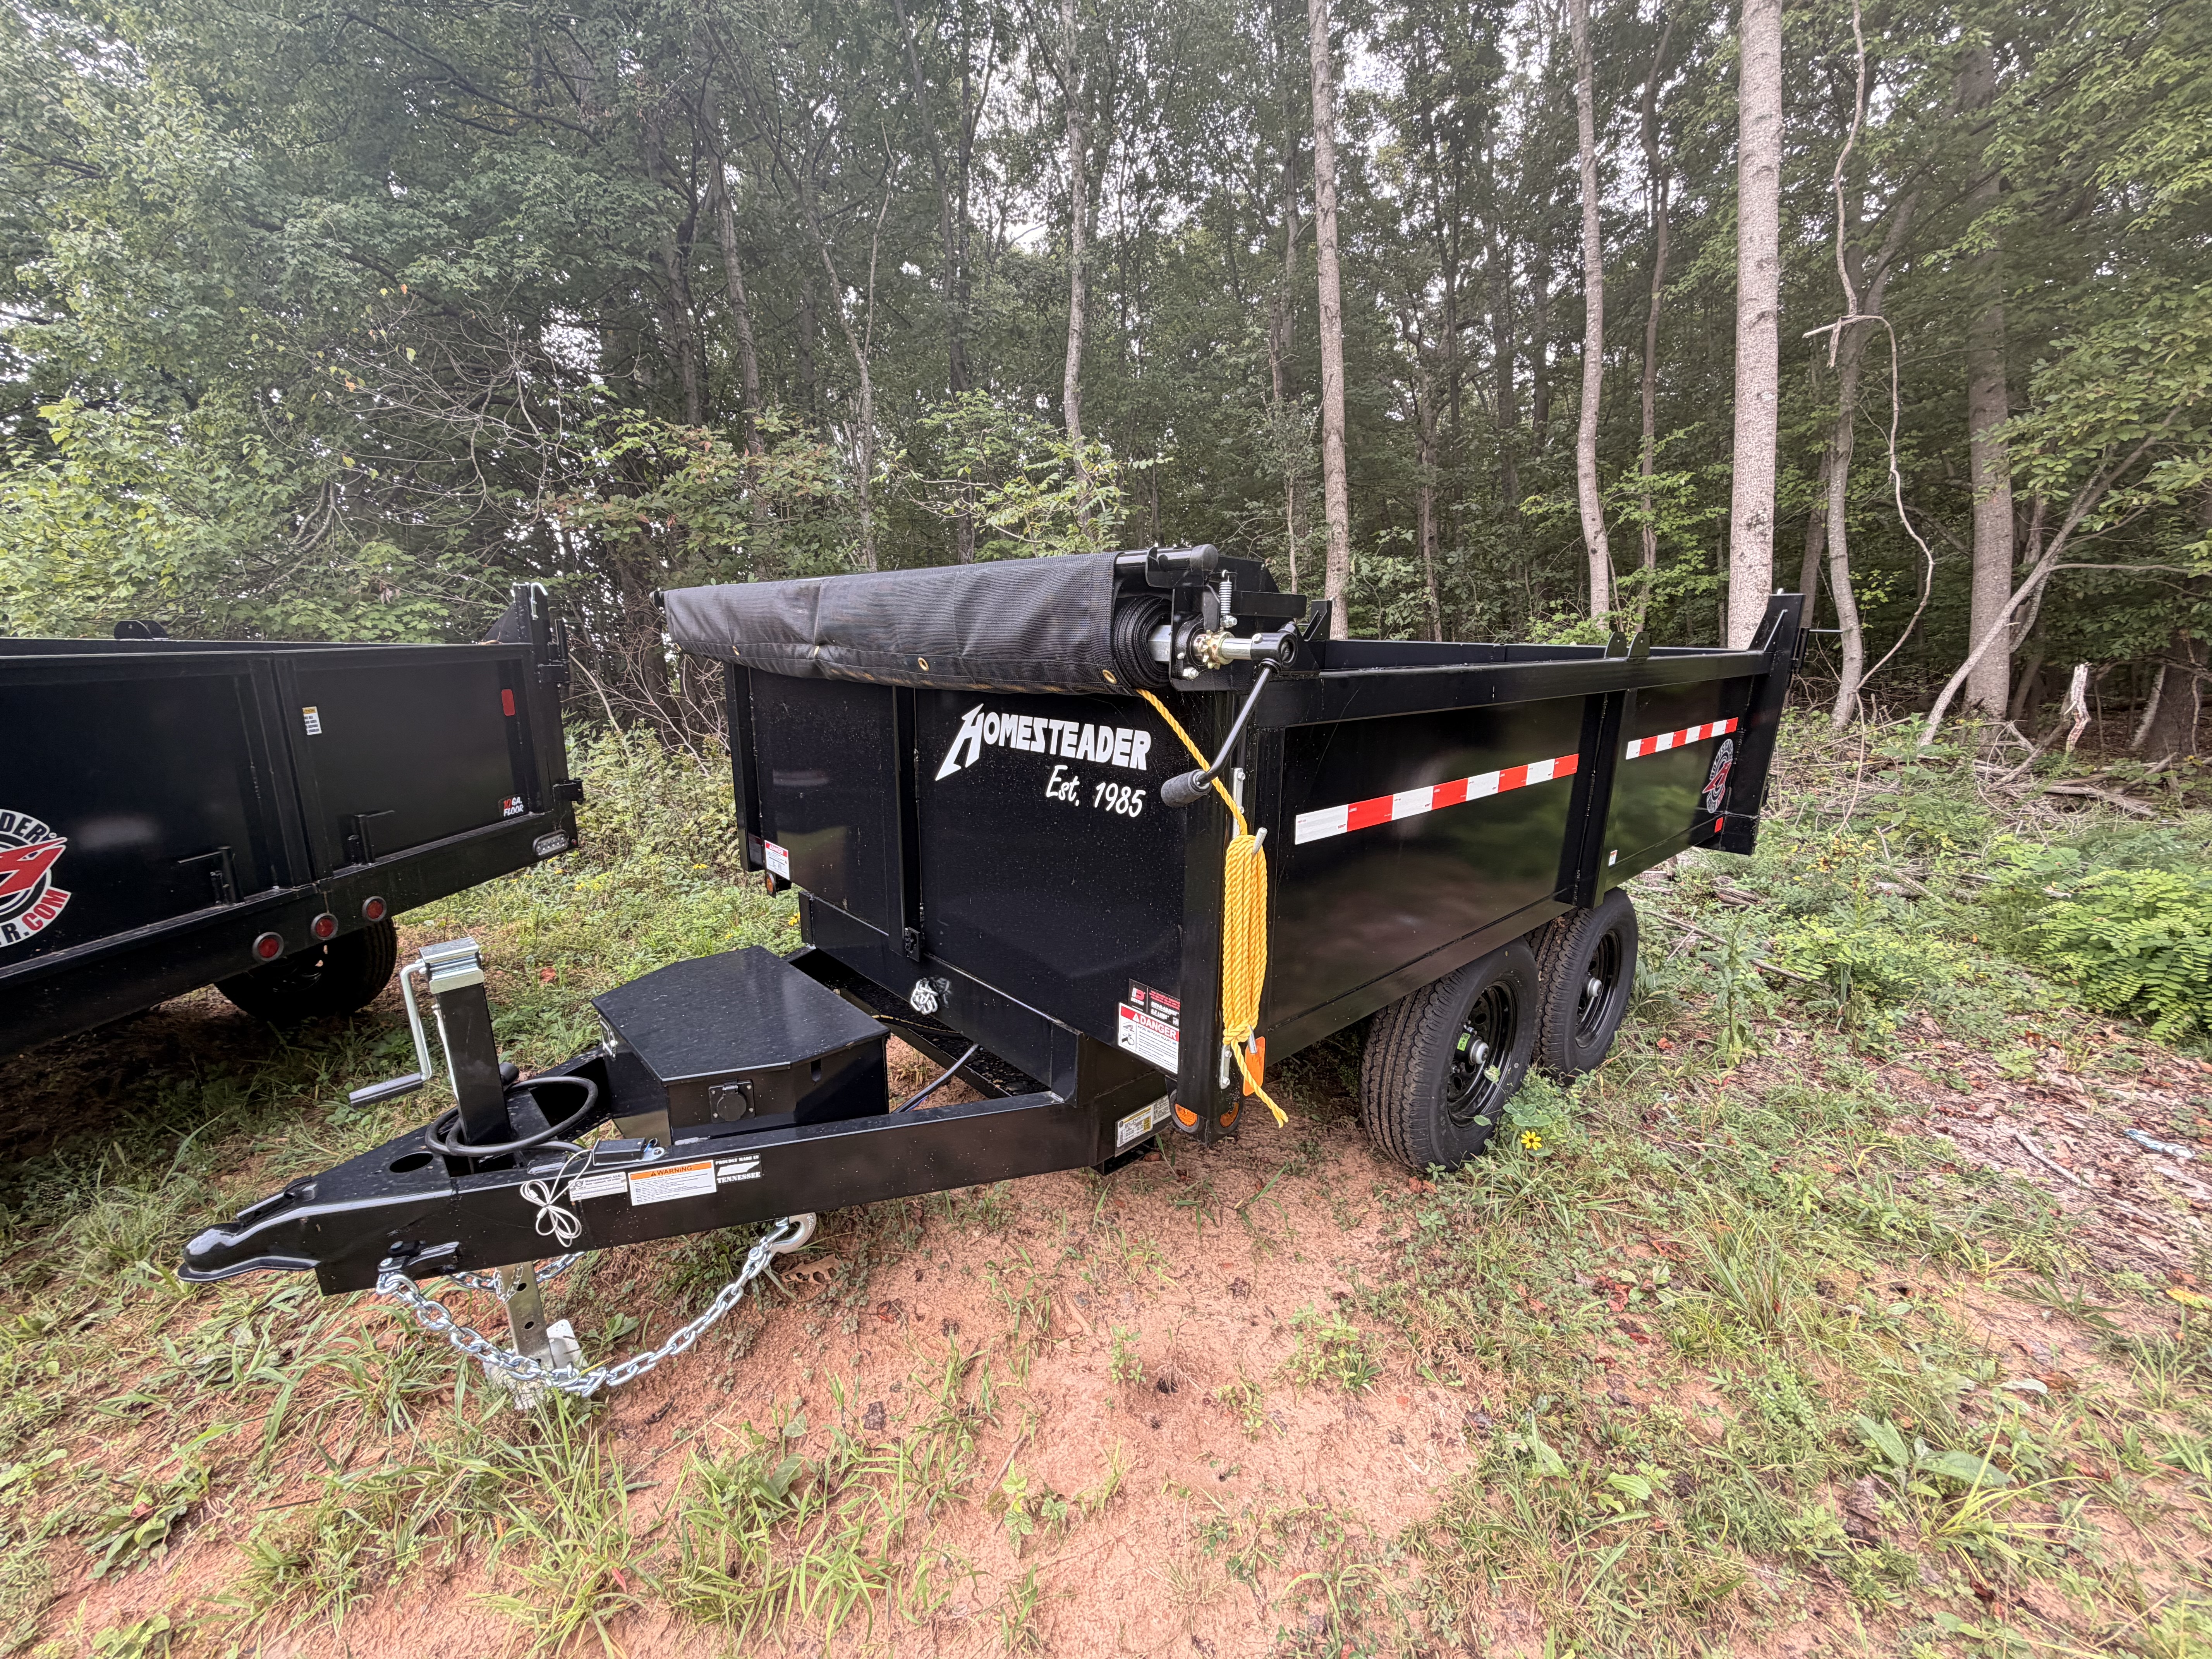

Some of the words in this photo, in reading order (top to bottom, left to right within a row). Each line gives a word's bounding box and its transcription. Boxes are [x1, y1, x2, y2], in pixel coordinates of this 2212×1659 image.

[935, 703, 1151, 781] HOMESTEADER
[1046, 764, 1080, 807] Est.
[1094, 782, 1146, 817] 1985
[503, 799, 511, 809] 10
[512, 797, 522, 805] GA.
[503, 804, 524, 817] FLOOR
[1140, 1015, 1176, 1040] DANGER
[657, 1166, 692, 1176] WARNING
[716, 1171, 761, 1183] TENNESSEE
